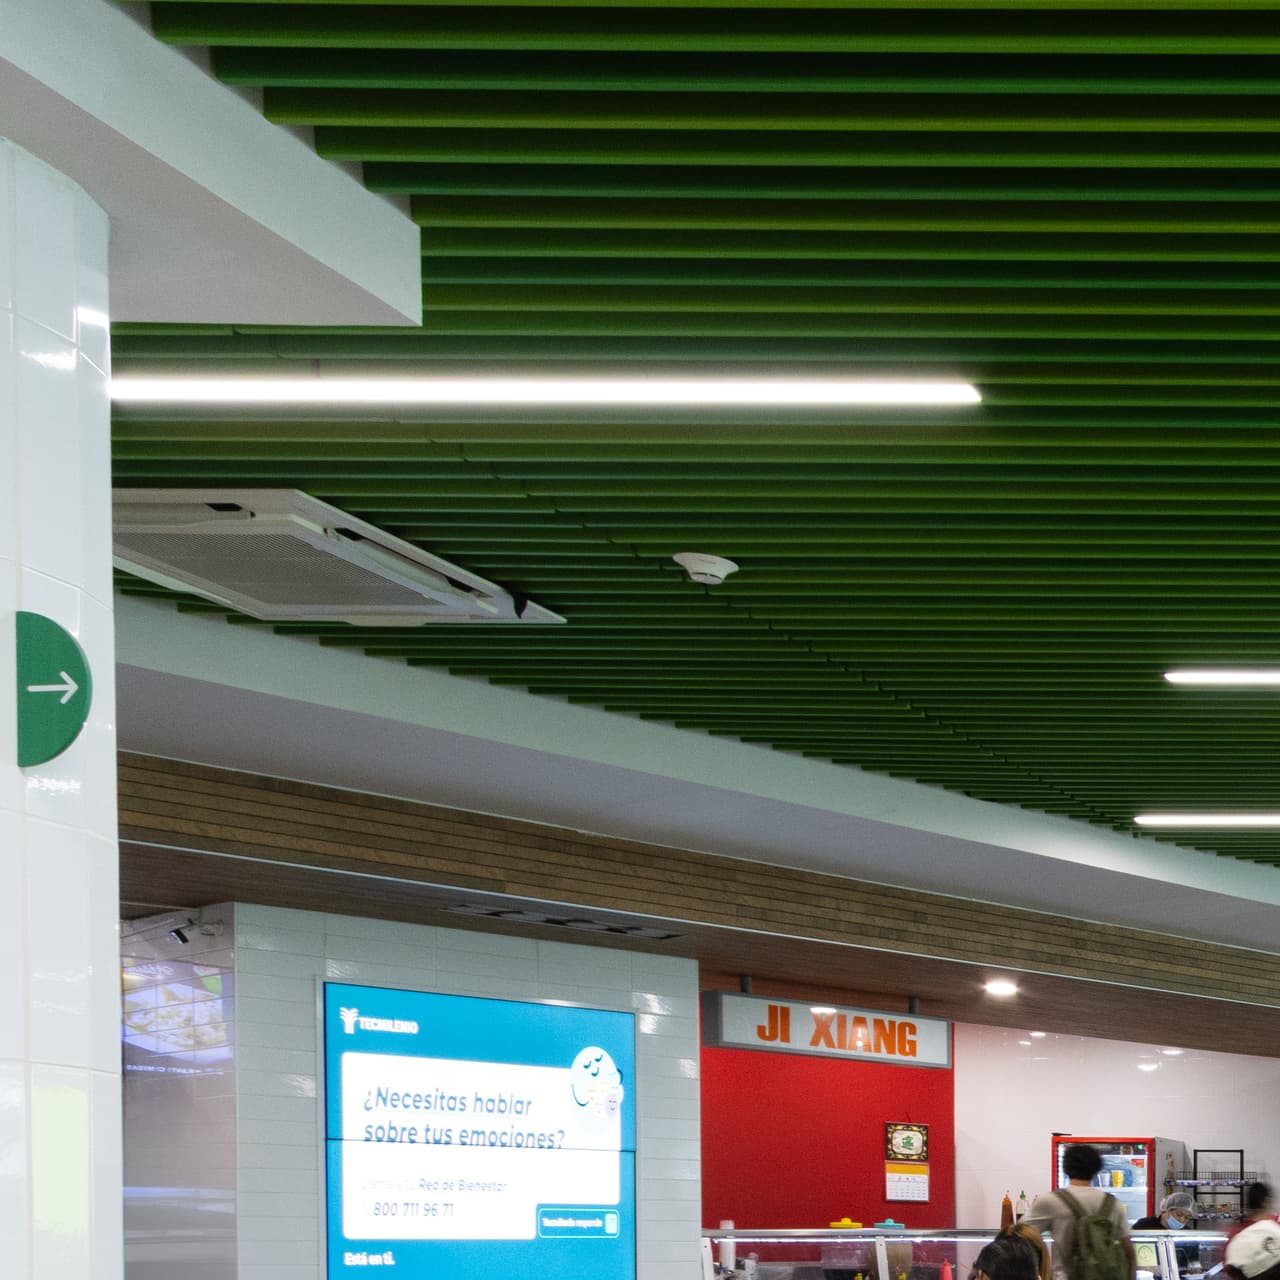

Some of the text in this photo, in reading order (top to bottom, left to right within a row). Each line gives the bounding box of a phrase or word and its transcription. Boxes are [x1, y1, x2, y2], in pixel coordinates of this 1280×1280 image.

[756, 1004, 917, 1057] JI XIANG
[363, 1086, 533, 1116] ¿Necesitas hablar
[364, 1120, 565, 1150] sobre tus emociones?
[373, 1202, 398, 1216] 800
[402, 1202, 420, 1216] 711
[423, 1202, 439, 1216] 96
